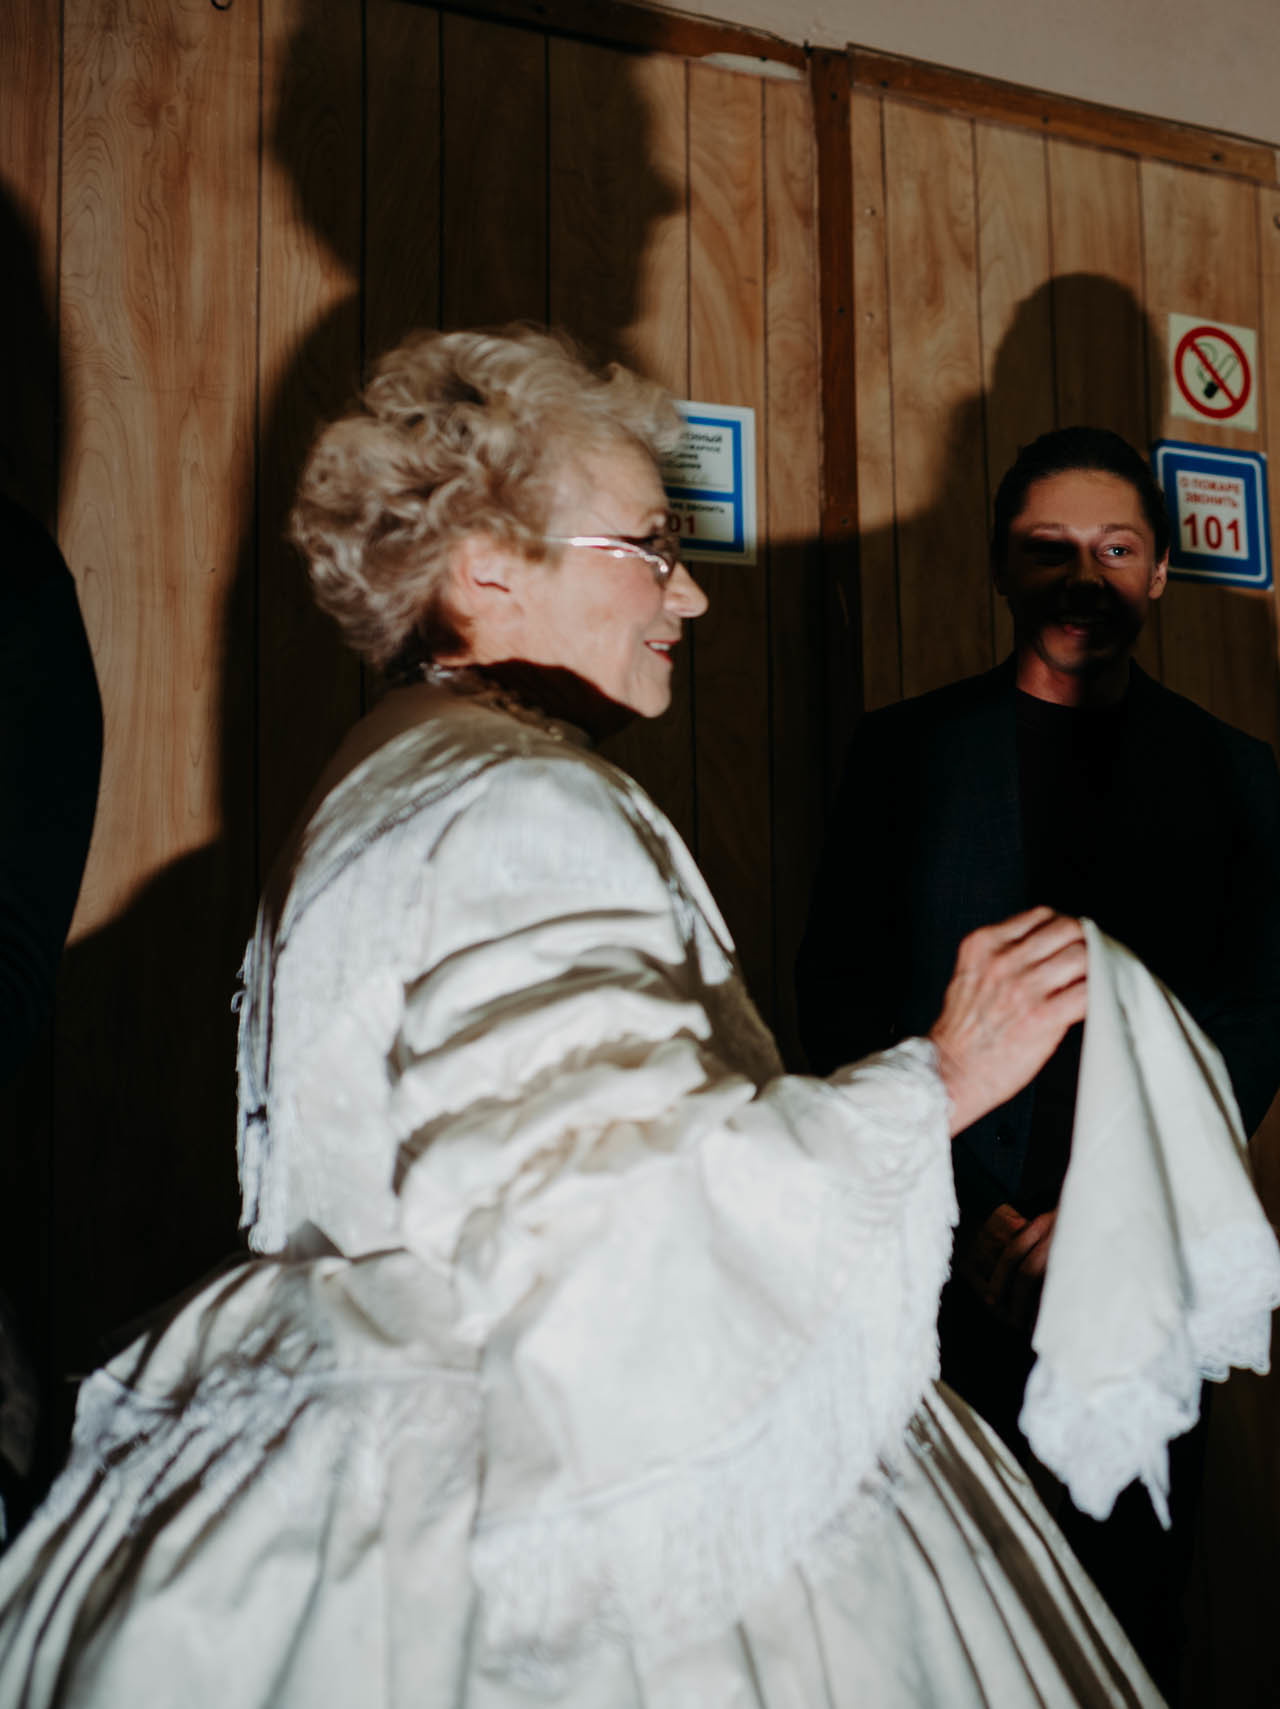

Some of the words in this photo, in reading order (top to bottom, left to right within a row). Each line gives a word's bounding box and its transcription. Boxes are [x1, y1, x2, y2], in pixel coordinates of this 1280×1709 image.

[1194, 479, 1239, 493] ПОЖАРЕ
[669, 514, 695, 534] 01
[1183, 513, 1240, 552] 101
